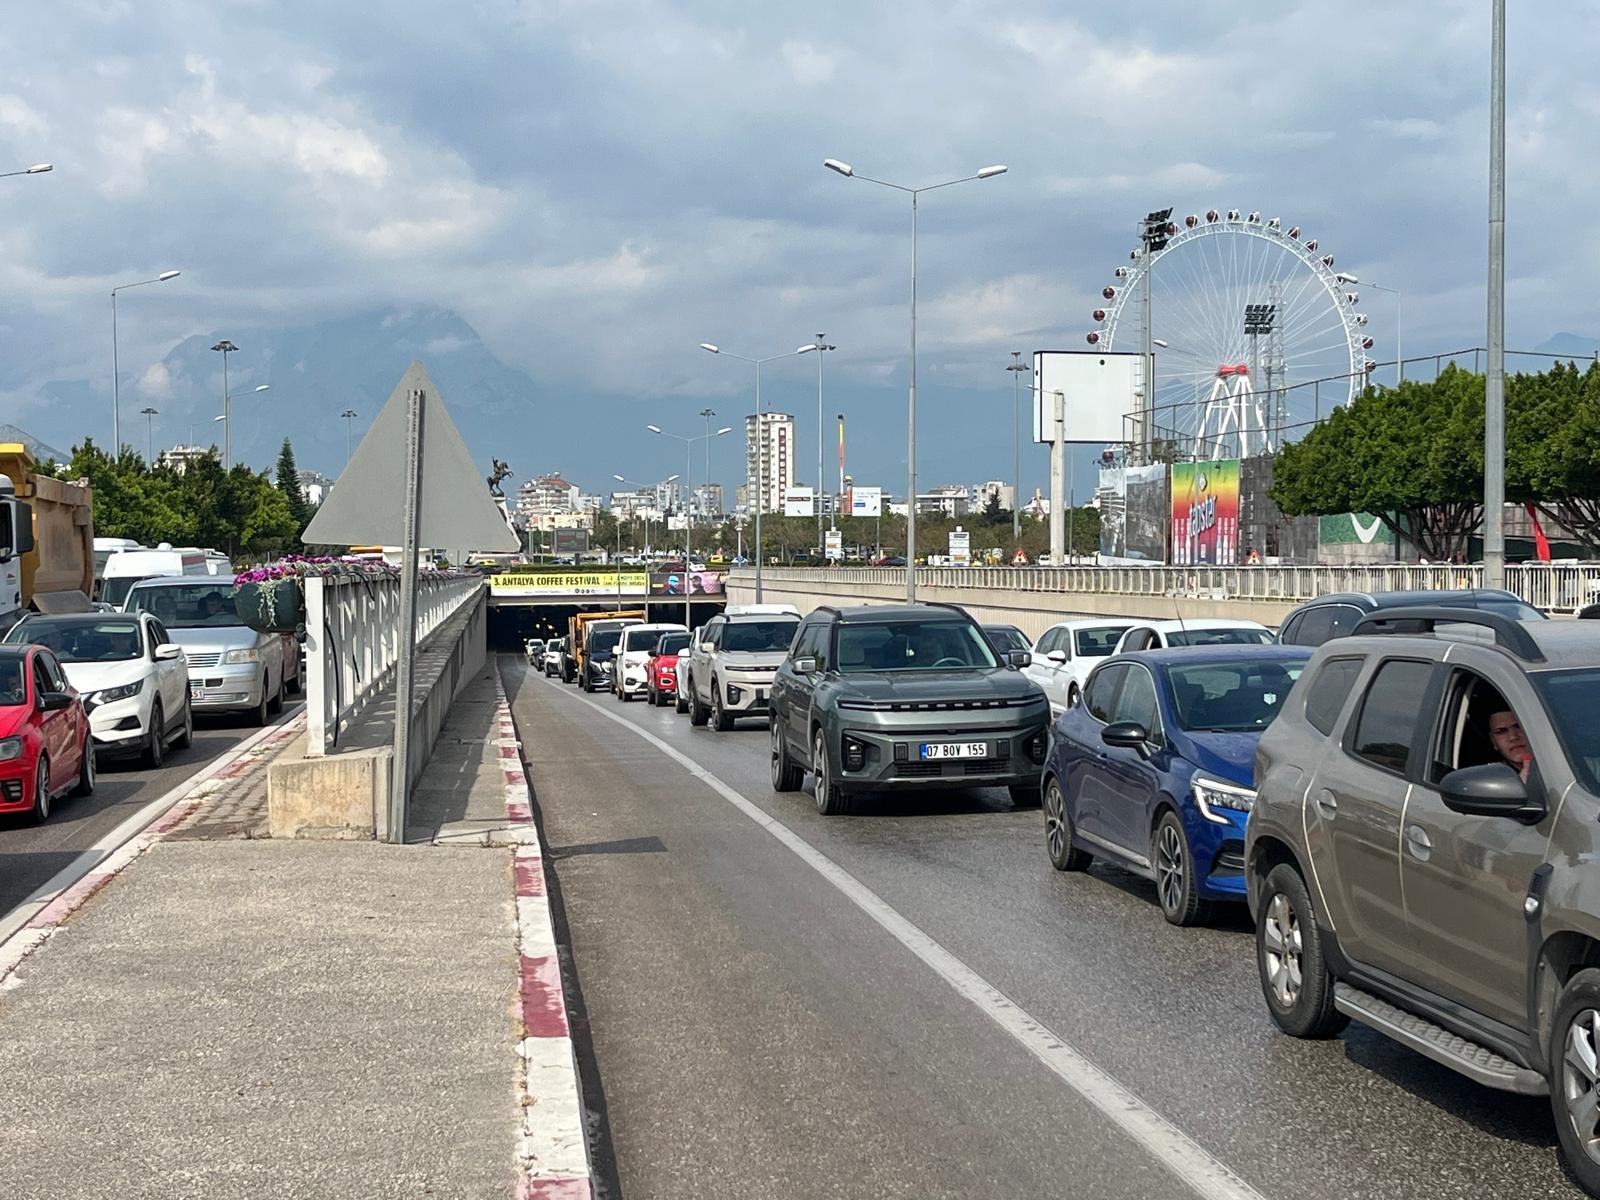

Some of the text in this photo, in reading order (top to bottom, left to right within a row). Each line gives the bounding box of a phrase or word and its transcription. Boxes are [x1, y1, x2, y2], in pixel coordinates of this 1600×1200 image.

[494, 577, 500, 586] 3.
[502, 577, 534, 586] ANTALYA
[537, 576, 563, 586] COFFEE
[566, 576, 600, 585] FESTIVAL
[927, 745, 938, 757] 07
[967, 743, 985, 756] 155
